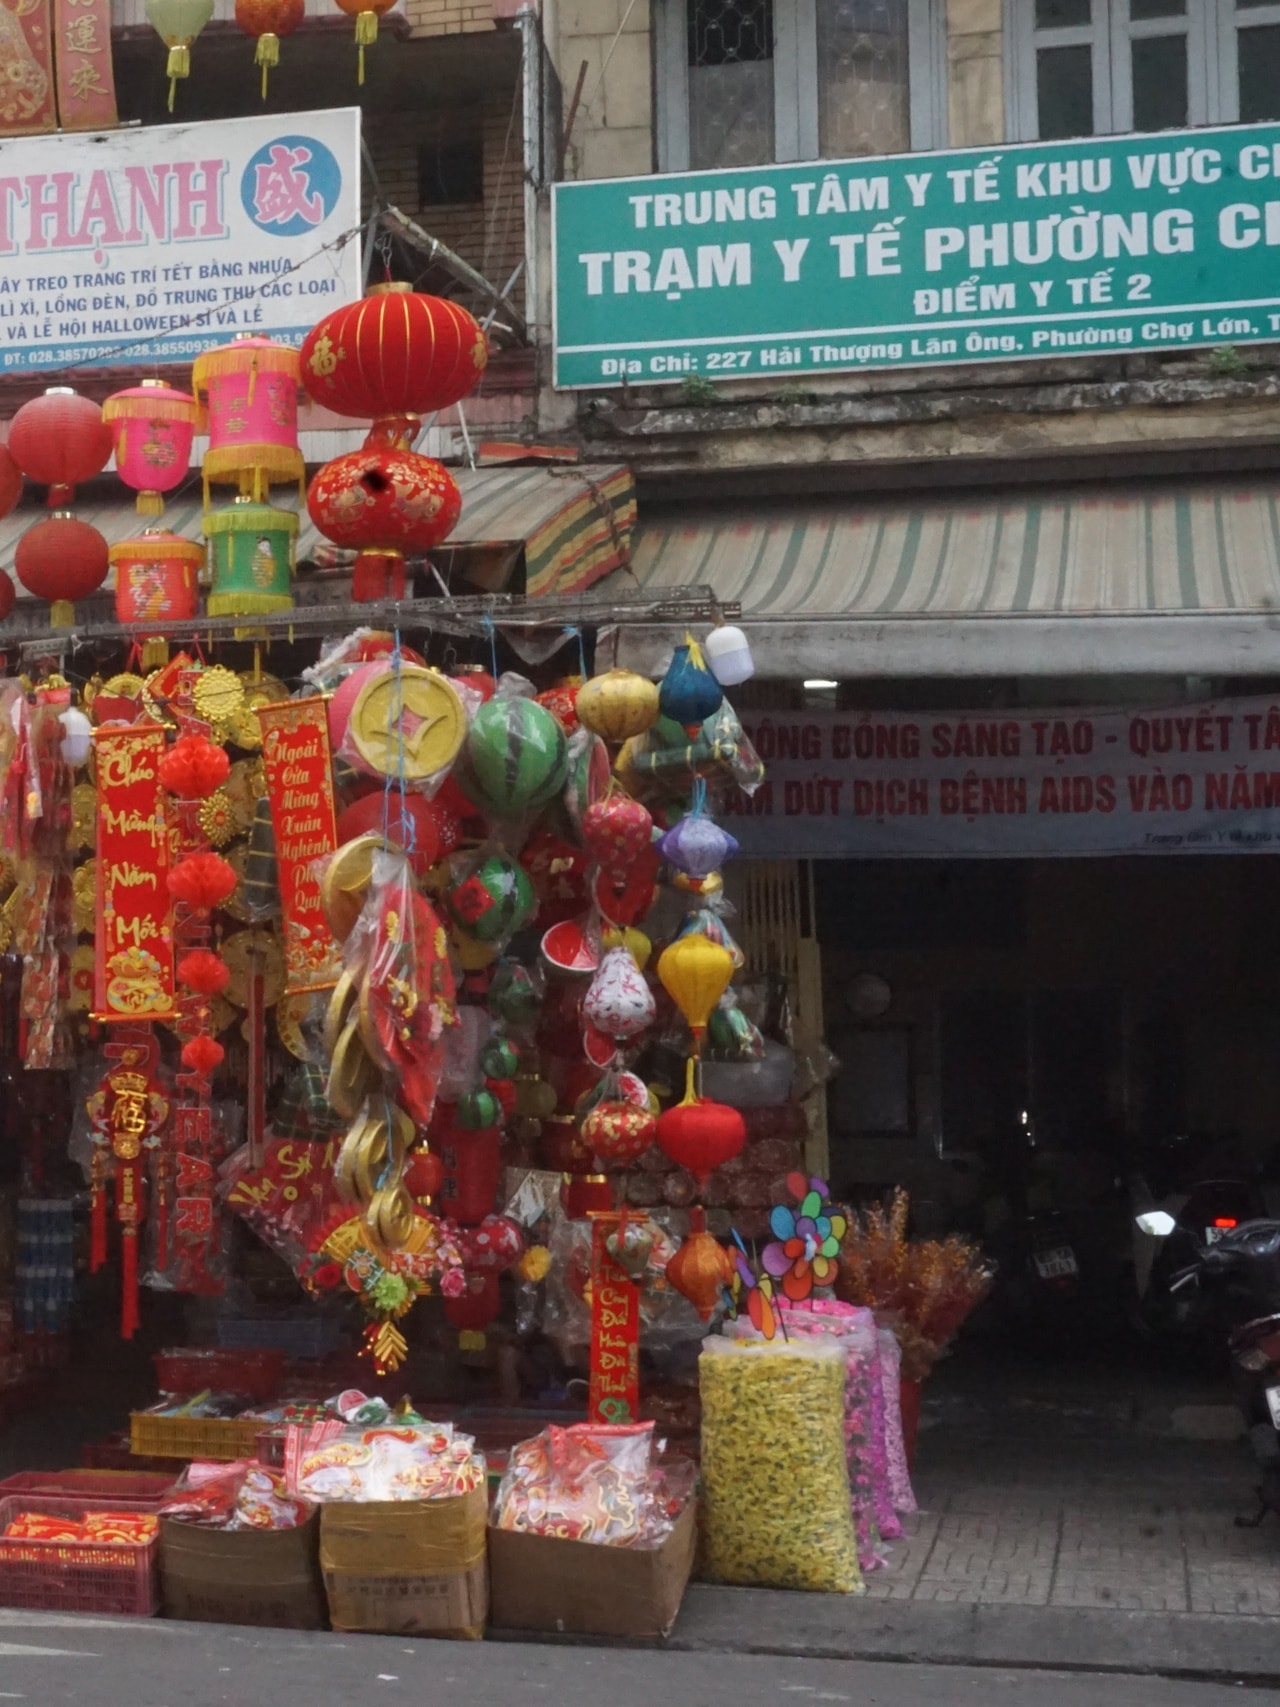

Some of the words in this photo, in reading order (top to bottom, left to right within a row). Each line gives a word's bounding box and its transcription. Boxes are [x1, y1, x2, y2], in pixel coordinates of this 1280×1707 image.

[65, 0, 109, 100] 運來
[629, 186, 776, 228] TRUNG
[791, 173, 889, 216] TÂM
[904, 173, 932, 207] Y
[947, 156, 1003, 203] TẾ
[1017, 158, 1111, 198] KHU
[1127, 147, 1221, 194] VỰC
[27, 277, 67, 291] TREO
[73, 271, 126, 288] TRANG
[132, 265, 157, 284] TRÍ
[163, 259, 192, 282] TẾT
[199, 258, 243, 279] BẰNG
[248, 257, 293, 276] NHỰA
[578, 242, 751, 300] TRẠM
[773, 238, 810, 282] Y
[830, 216, 906, 278] TẾ
[924, 205, 1194, 272] PHƯỜNG
[0, 299, 14, 317] LÌ
[19, 296, 40, 317] XÌ,
[45, 292, 87, 314] LỒNG
[93, 289, 129, 312] ĐÈN,
[136, 286, 157, 307] ĐỒ
[165, 287, 217, 304] TRUNG
[223, 284, 254, 300] THU
[260, 279, 292, 297] CÁC
[298, 278, 336, 297] LOẠI
[913, 275, 1016, 316] ĐIỂM
[1029, 281, 1053, 307] Y
[1066, 267, 1115, 304] TẾ
[1127, 274, 1151, 300] 2
[7, 322, 26, 340] VÀ
[33, 317, 51, 338] LỄ
[59, 314, 87, 337] HỘI
[92, 313, 191, 333] HALLOWEEN
[216, 307, 237, 325] VÀ
[601, 358, 642, 378] Địa
[650, 352, 698, 373] Chỉ:
[706, 351, 752, 370] 227
[760, 345, 800, 366] Hải
[809, 340, 902, 363] Thượng
[911, 337, 957, 356] Lãn
[965, 331, 1024, 352] Ông,
[1032, 325, 1133, 348] Phường
[1141, 320, 1193, 341] Chợ
[1202, 316, 1259, 337] Lớn,
[4, 352, 25, 366] ĐT:
[832, 711, 921, 760] ĐỒNG
[931, 716, 1020, 758] SÁNG
[1032, 721, 1094, 765] TẠO
[1128, 704, 1236, 757] QUYẾT
[785, 771, 843, 816] DỨT
[854, 777, 928, 824] DỊCH
[940, 769, 1027, 823] BỆNH
[1039, 774, 1117, 814] AIDS
[1128, 767, 1194, 814] VÀO
[1205, 764, 1280, 810] NĂM
